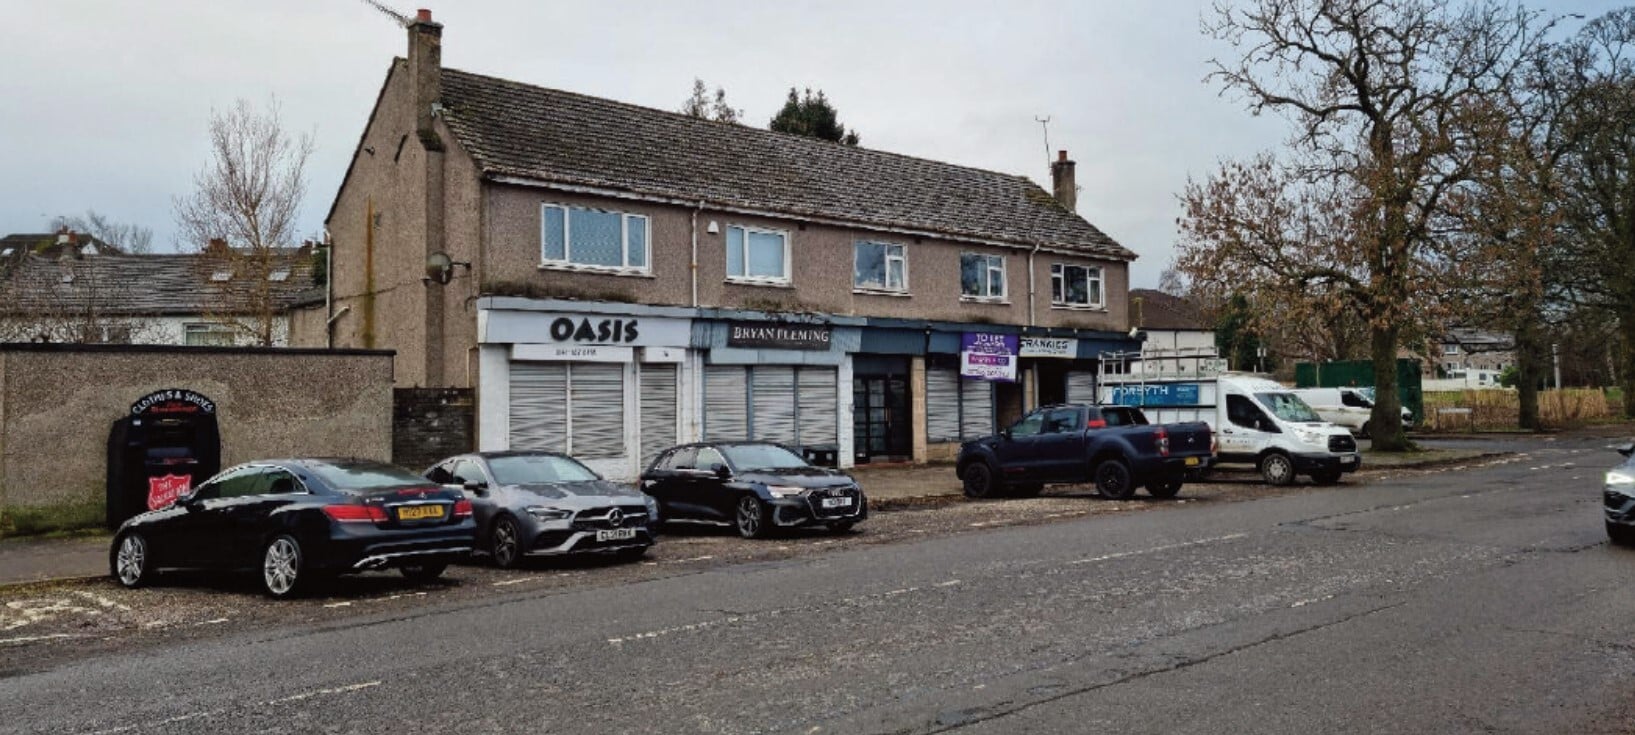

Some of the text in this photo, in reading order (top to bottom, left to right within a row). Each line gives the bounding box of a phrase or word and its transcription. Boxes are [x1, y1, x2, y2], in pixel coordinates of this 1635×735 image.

[550, 317, 638, 342] OASIS
[733, 326, 829, 342] BRYAN FLEMING
[976, 333, 988, 342] TO
[132, 391, 172, 413] CLOTHES
[185, 392, 214, 412] SHOES
